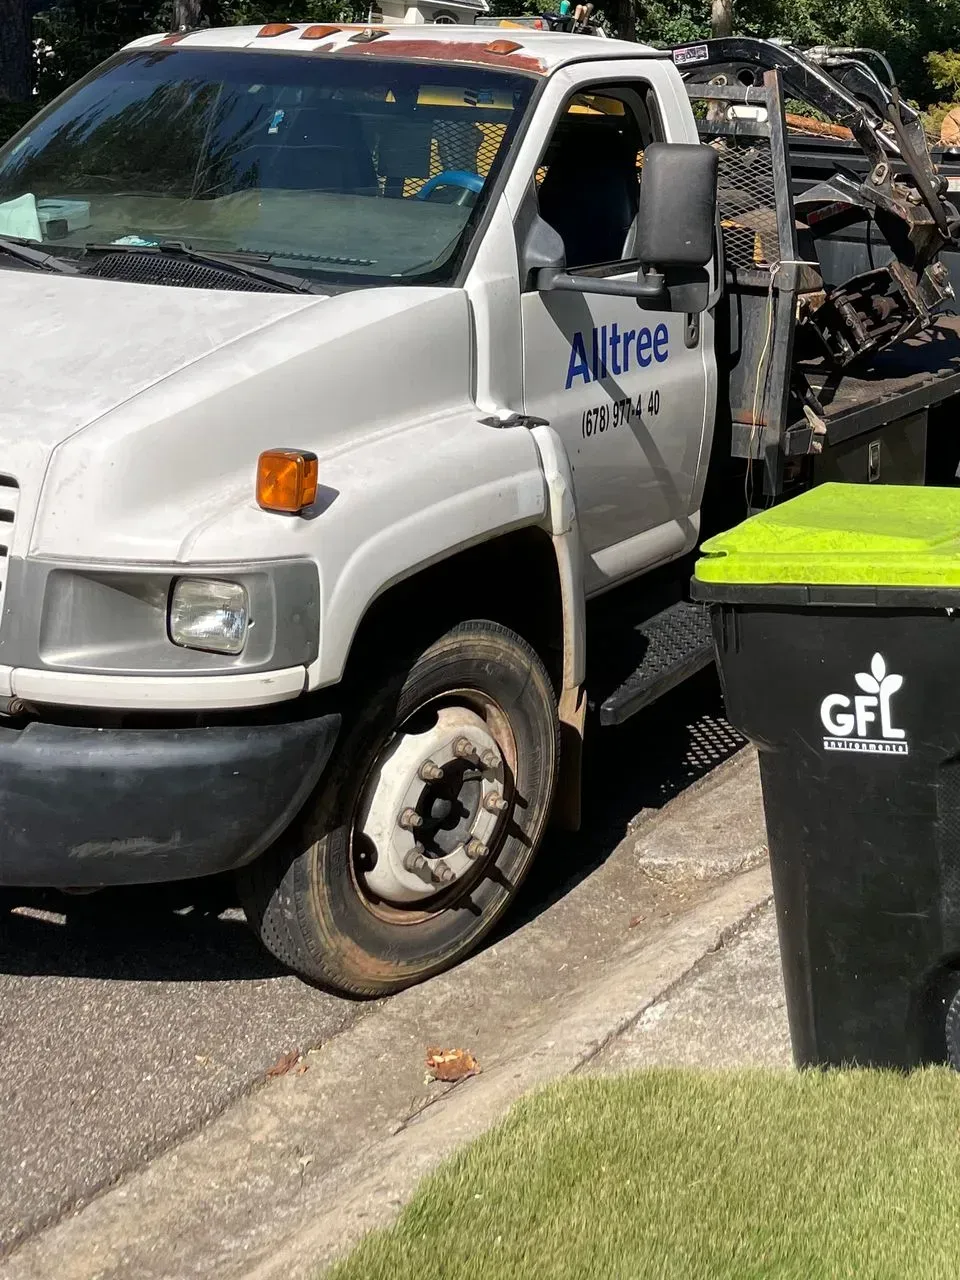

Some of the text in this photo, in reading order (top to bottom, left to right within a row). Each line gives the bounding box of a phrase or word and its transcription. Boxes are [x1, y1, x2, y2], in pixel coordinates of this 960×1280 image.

[565, 323, 669, 390] Alltree
[582, 404, 610, 439] (678)
[820, 673, 906, 739] GFL
[823, 740, 908, 753] environmental
